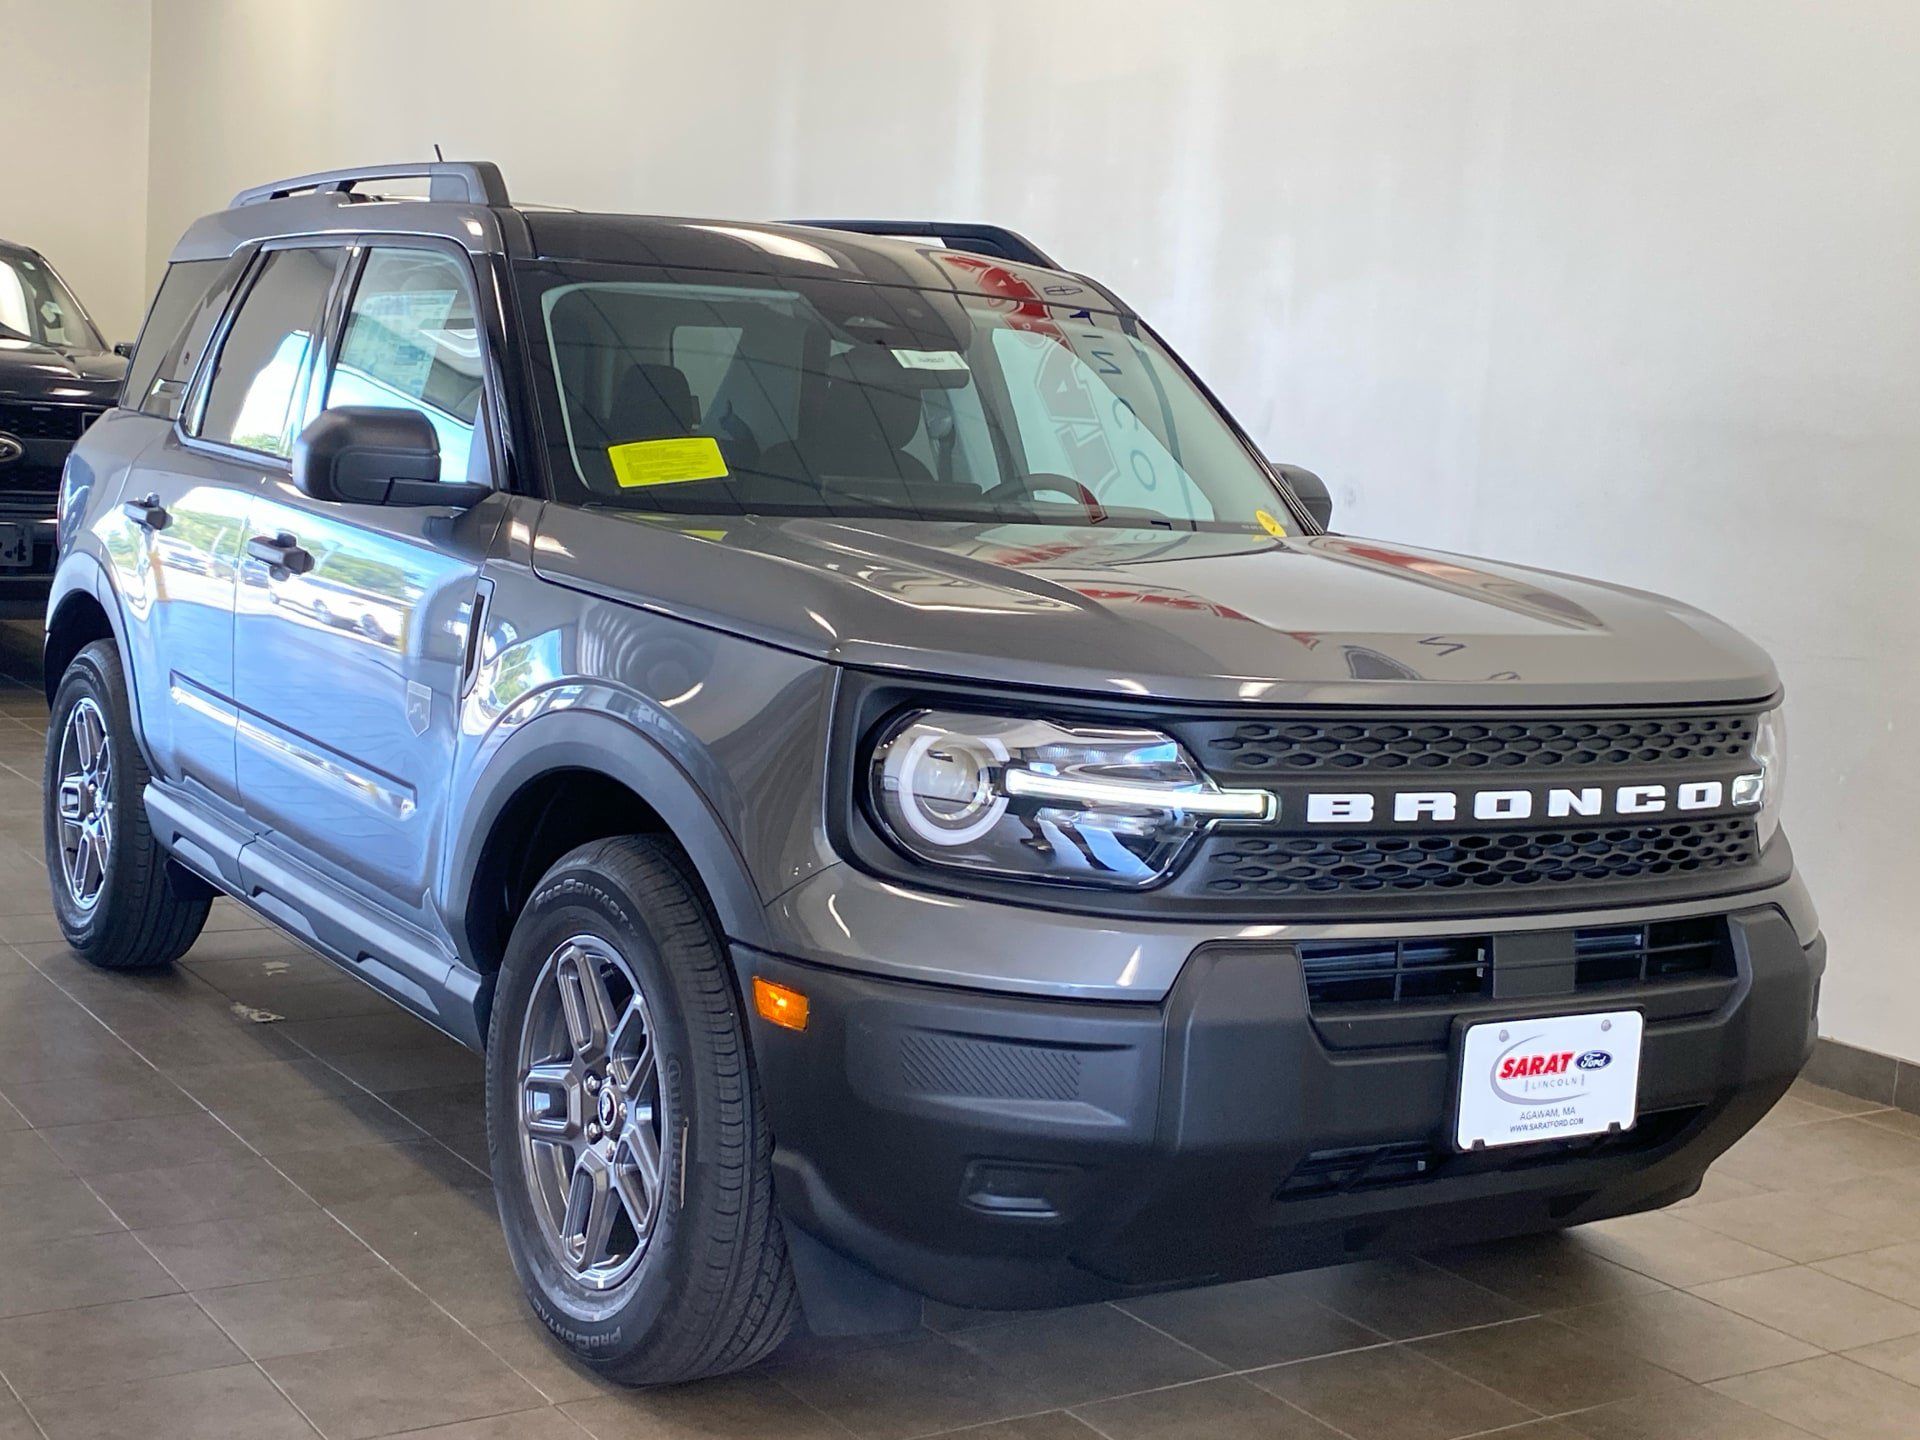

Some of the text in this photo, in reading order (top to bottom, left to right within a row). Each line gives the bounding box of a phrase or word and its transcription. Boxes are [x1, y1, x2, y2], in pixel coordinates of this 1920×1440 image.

[1306, 781, 1722, 823] BRONCO
[1500, 1053, 1607, 1079] SARAT Ford
[1531, 1077, 1578, 1090] LINCOLN
[1519, 1106, 1577, 1121] AGAWAM, MA
[1509, 1118, 1584, 1133] WWW.SARATFORD.COM
